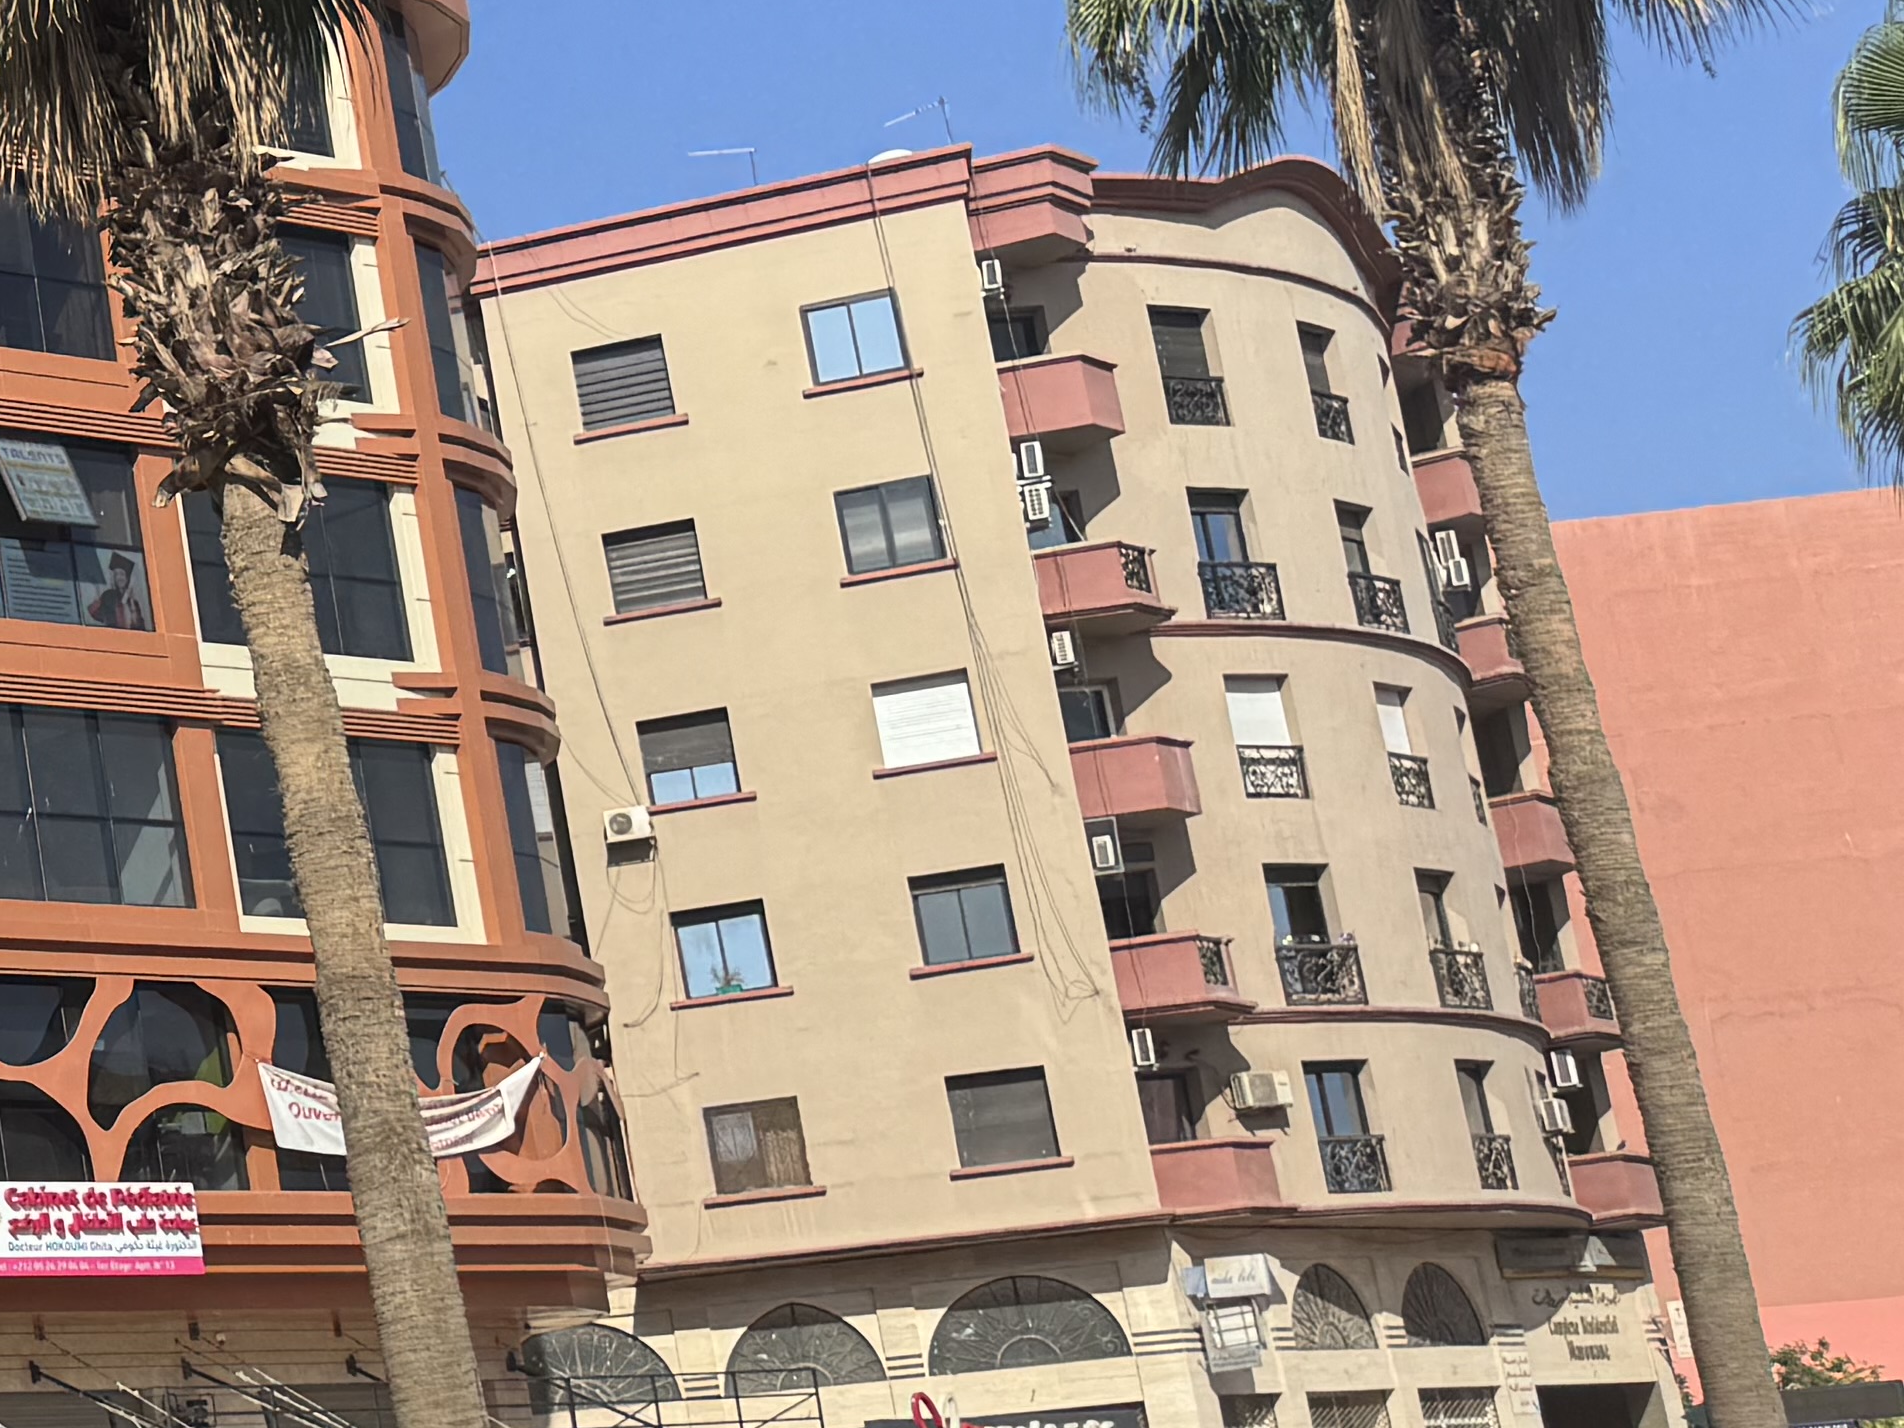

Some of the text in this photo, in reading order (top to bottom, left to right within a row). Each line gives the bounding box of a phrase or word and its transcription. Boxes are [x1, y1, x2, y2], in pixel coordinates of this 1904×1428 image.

[1, 446, 67, 465] TALENTS
[289, 1102, 341, 1123] Ouver
[4, 1186, 80, 1211] Cabinet
[83, 1186, 108, 1210] de
[8, 1241, 42, 1252] Docteur
